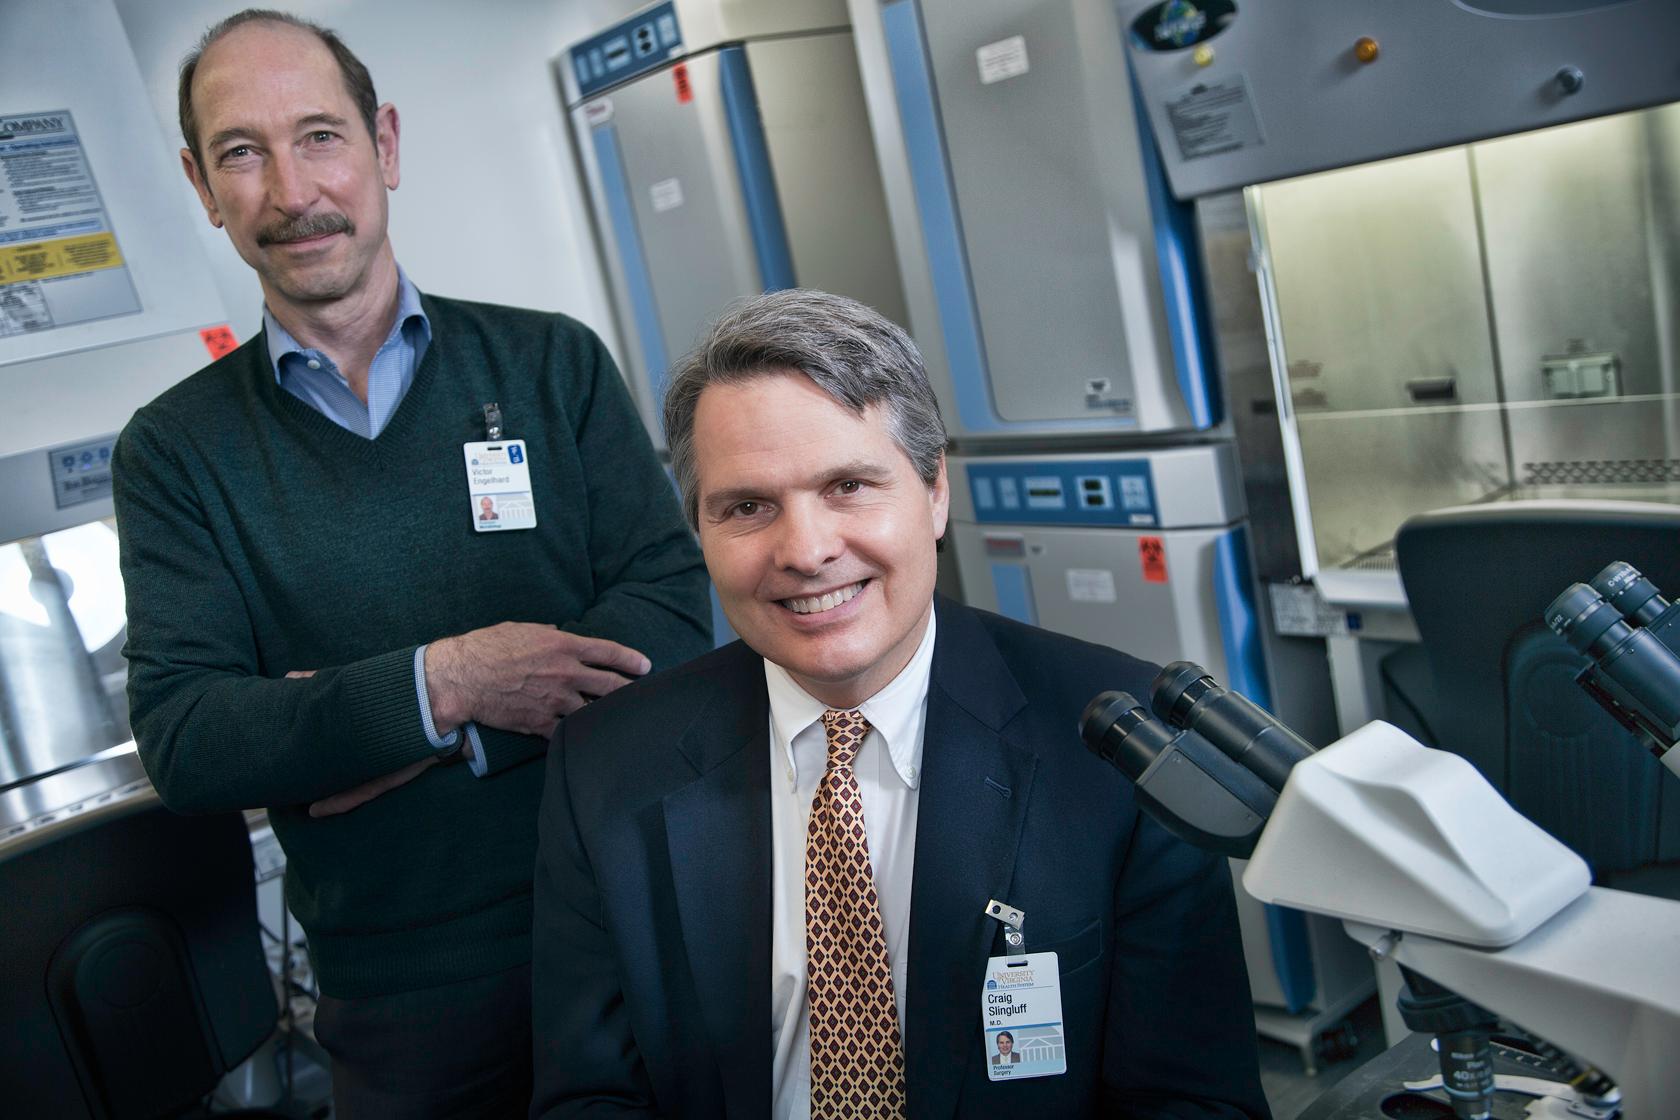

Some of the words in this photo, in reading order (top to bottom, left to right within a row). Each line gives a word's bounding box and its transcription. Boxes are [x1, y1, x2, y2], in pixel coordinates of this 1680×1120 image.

[0, 116, 65, 132] OMPANY
[987, 993, 1012, 1004] Craig
[988, 1003, 1027, 1017] Slingluff
